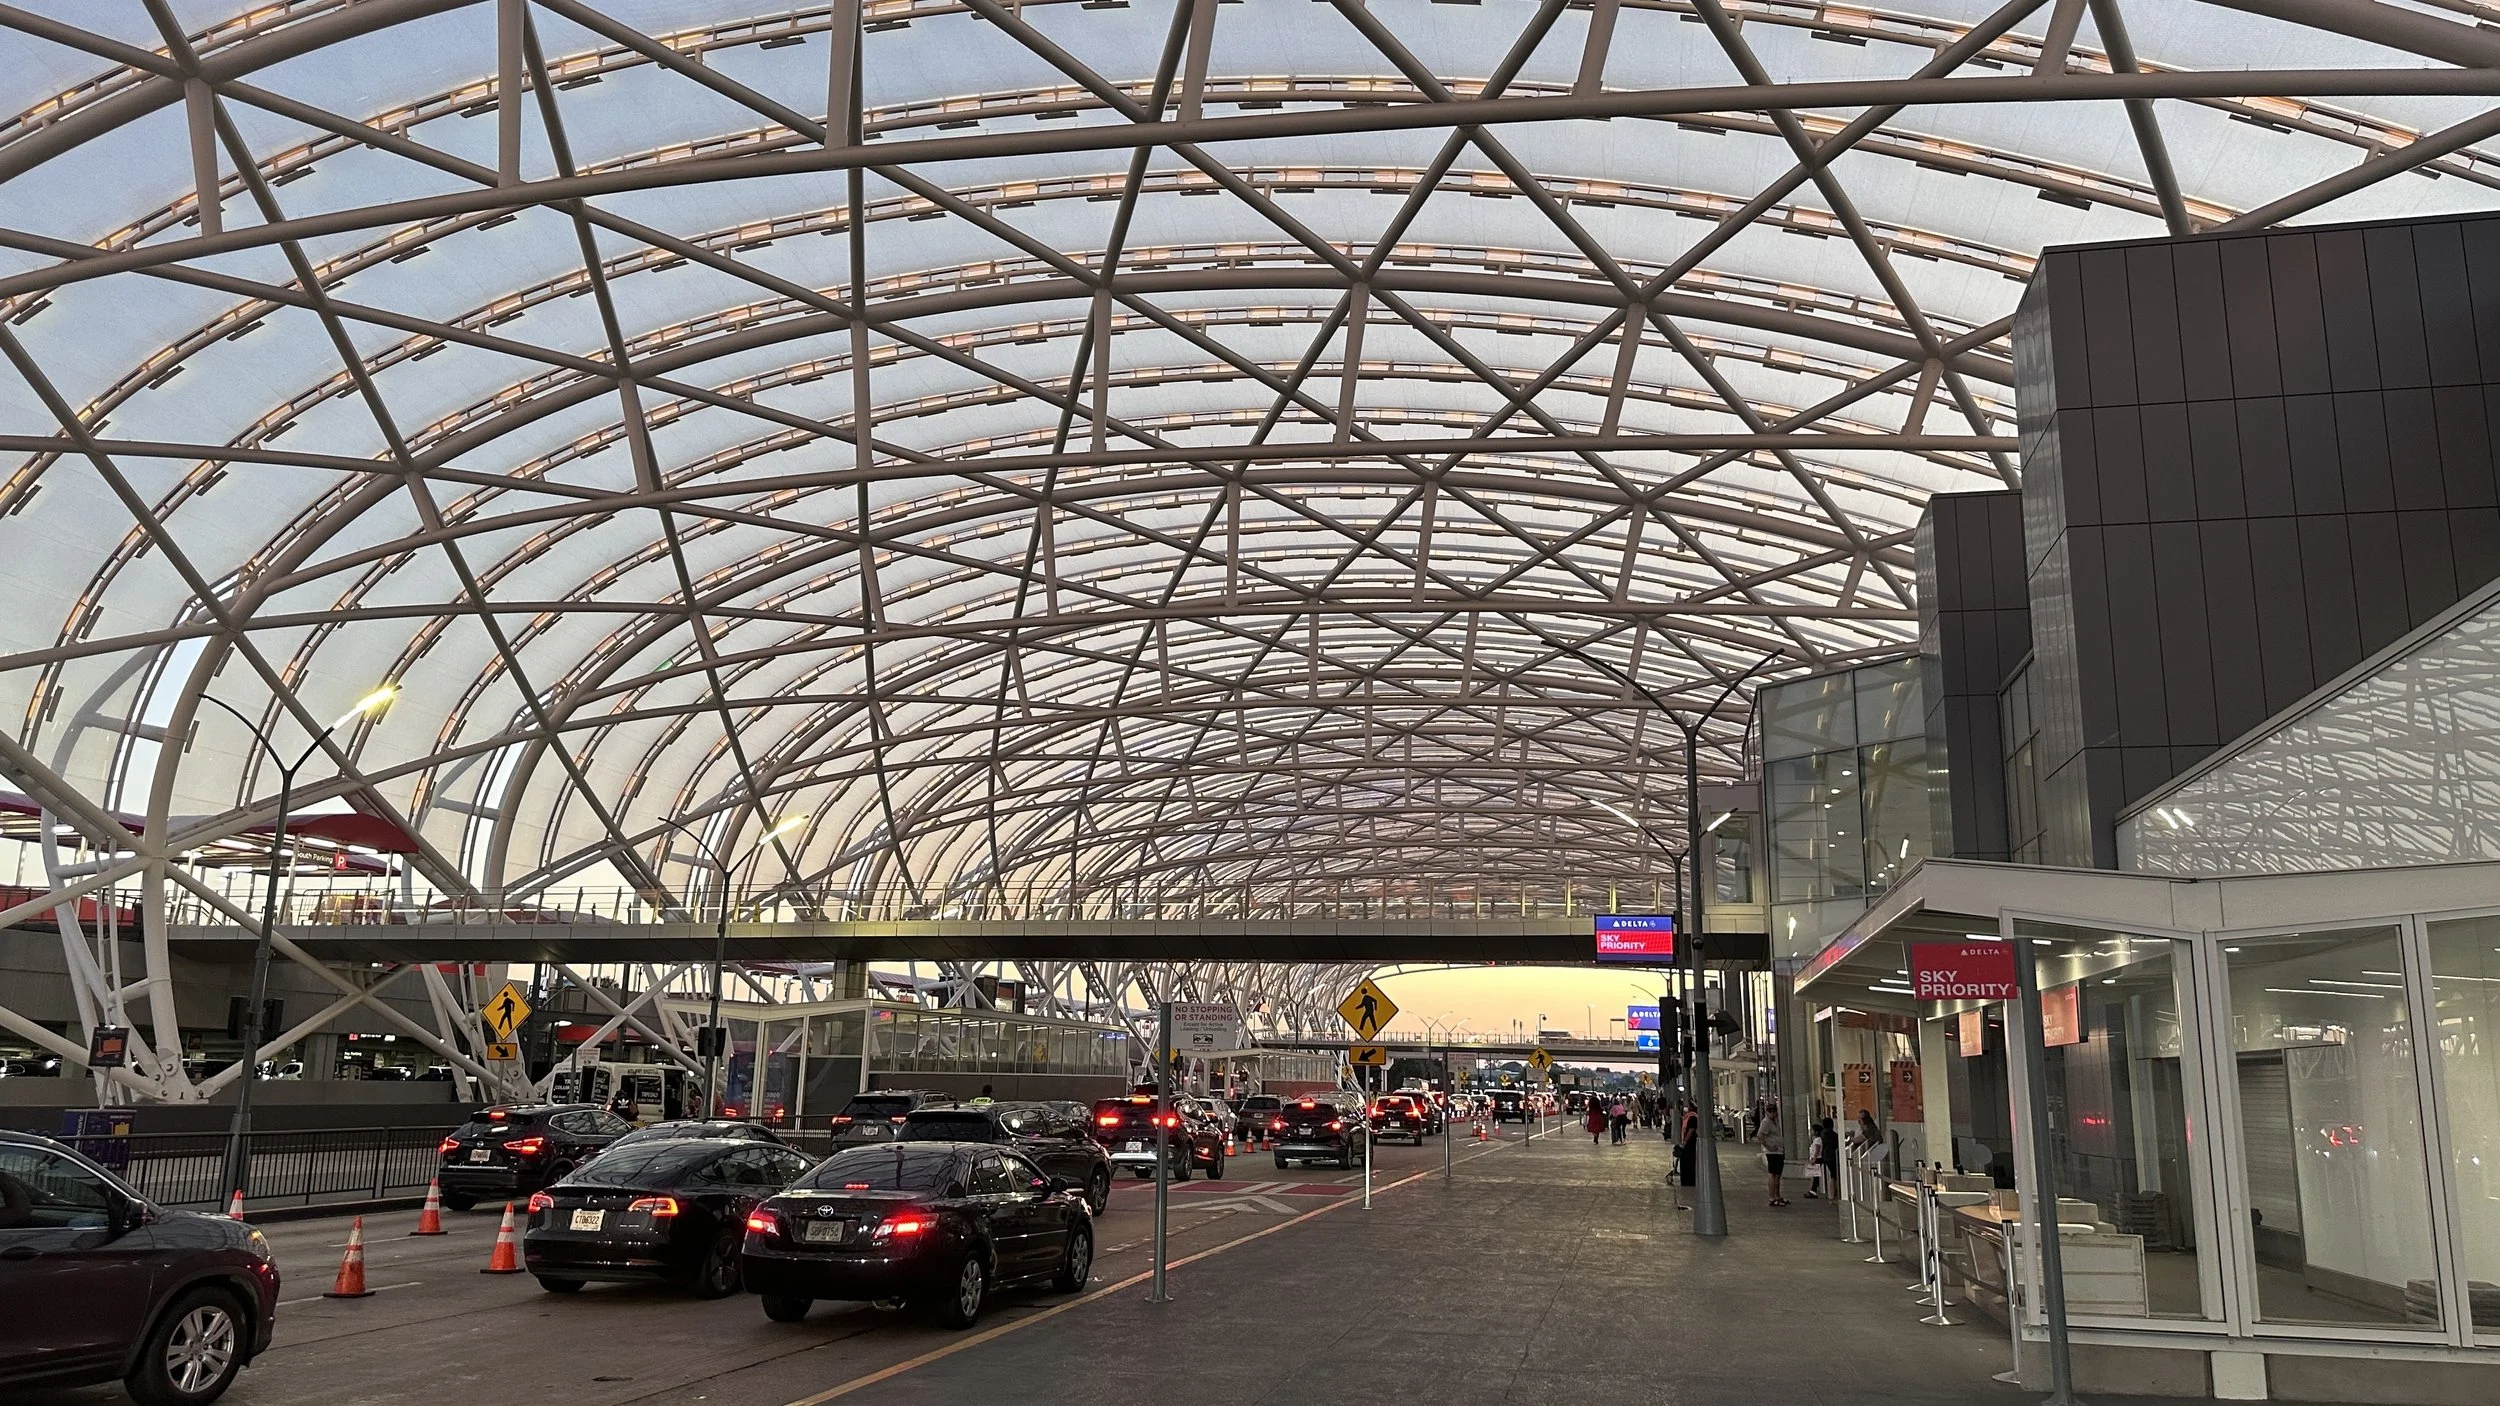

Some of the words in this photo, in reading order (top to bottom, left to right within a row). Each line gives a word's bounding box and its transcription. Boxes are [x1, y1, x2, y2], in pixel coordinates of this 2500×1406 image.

[312, 853, 334, 865] Parking
[1600, 941, 1646, 950] PRIORITY
[1920, 970, 1958, 983] SKY
[1920, 983, 2010, 996] PRIORITY
